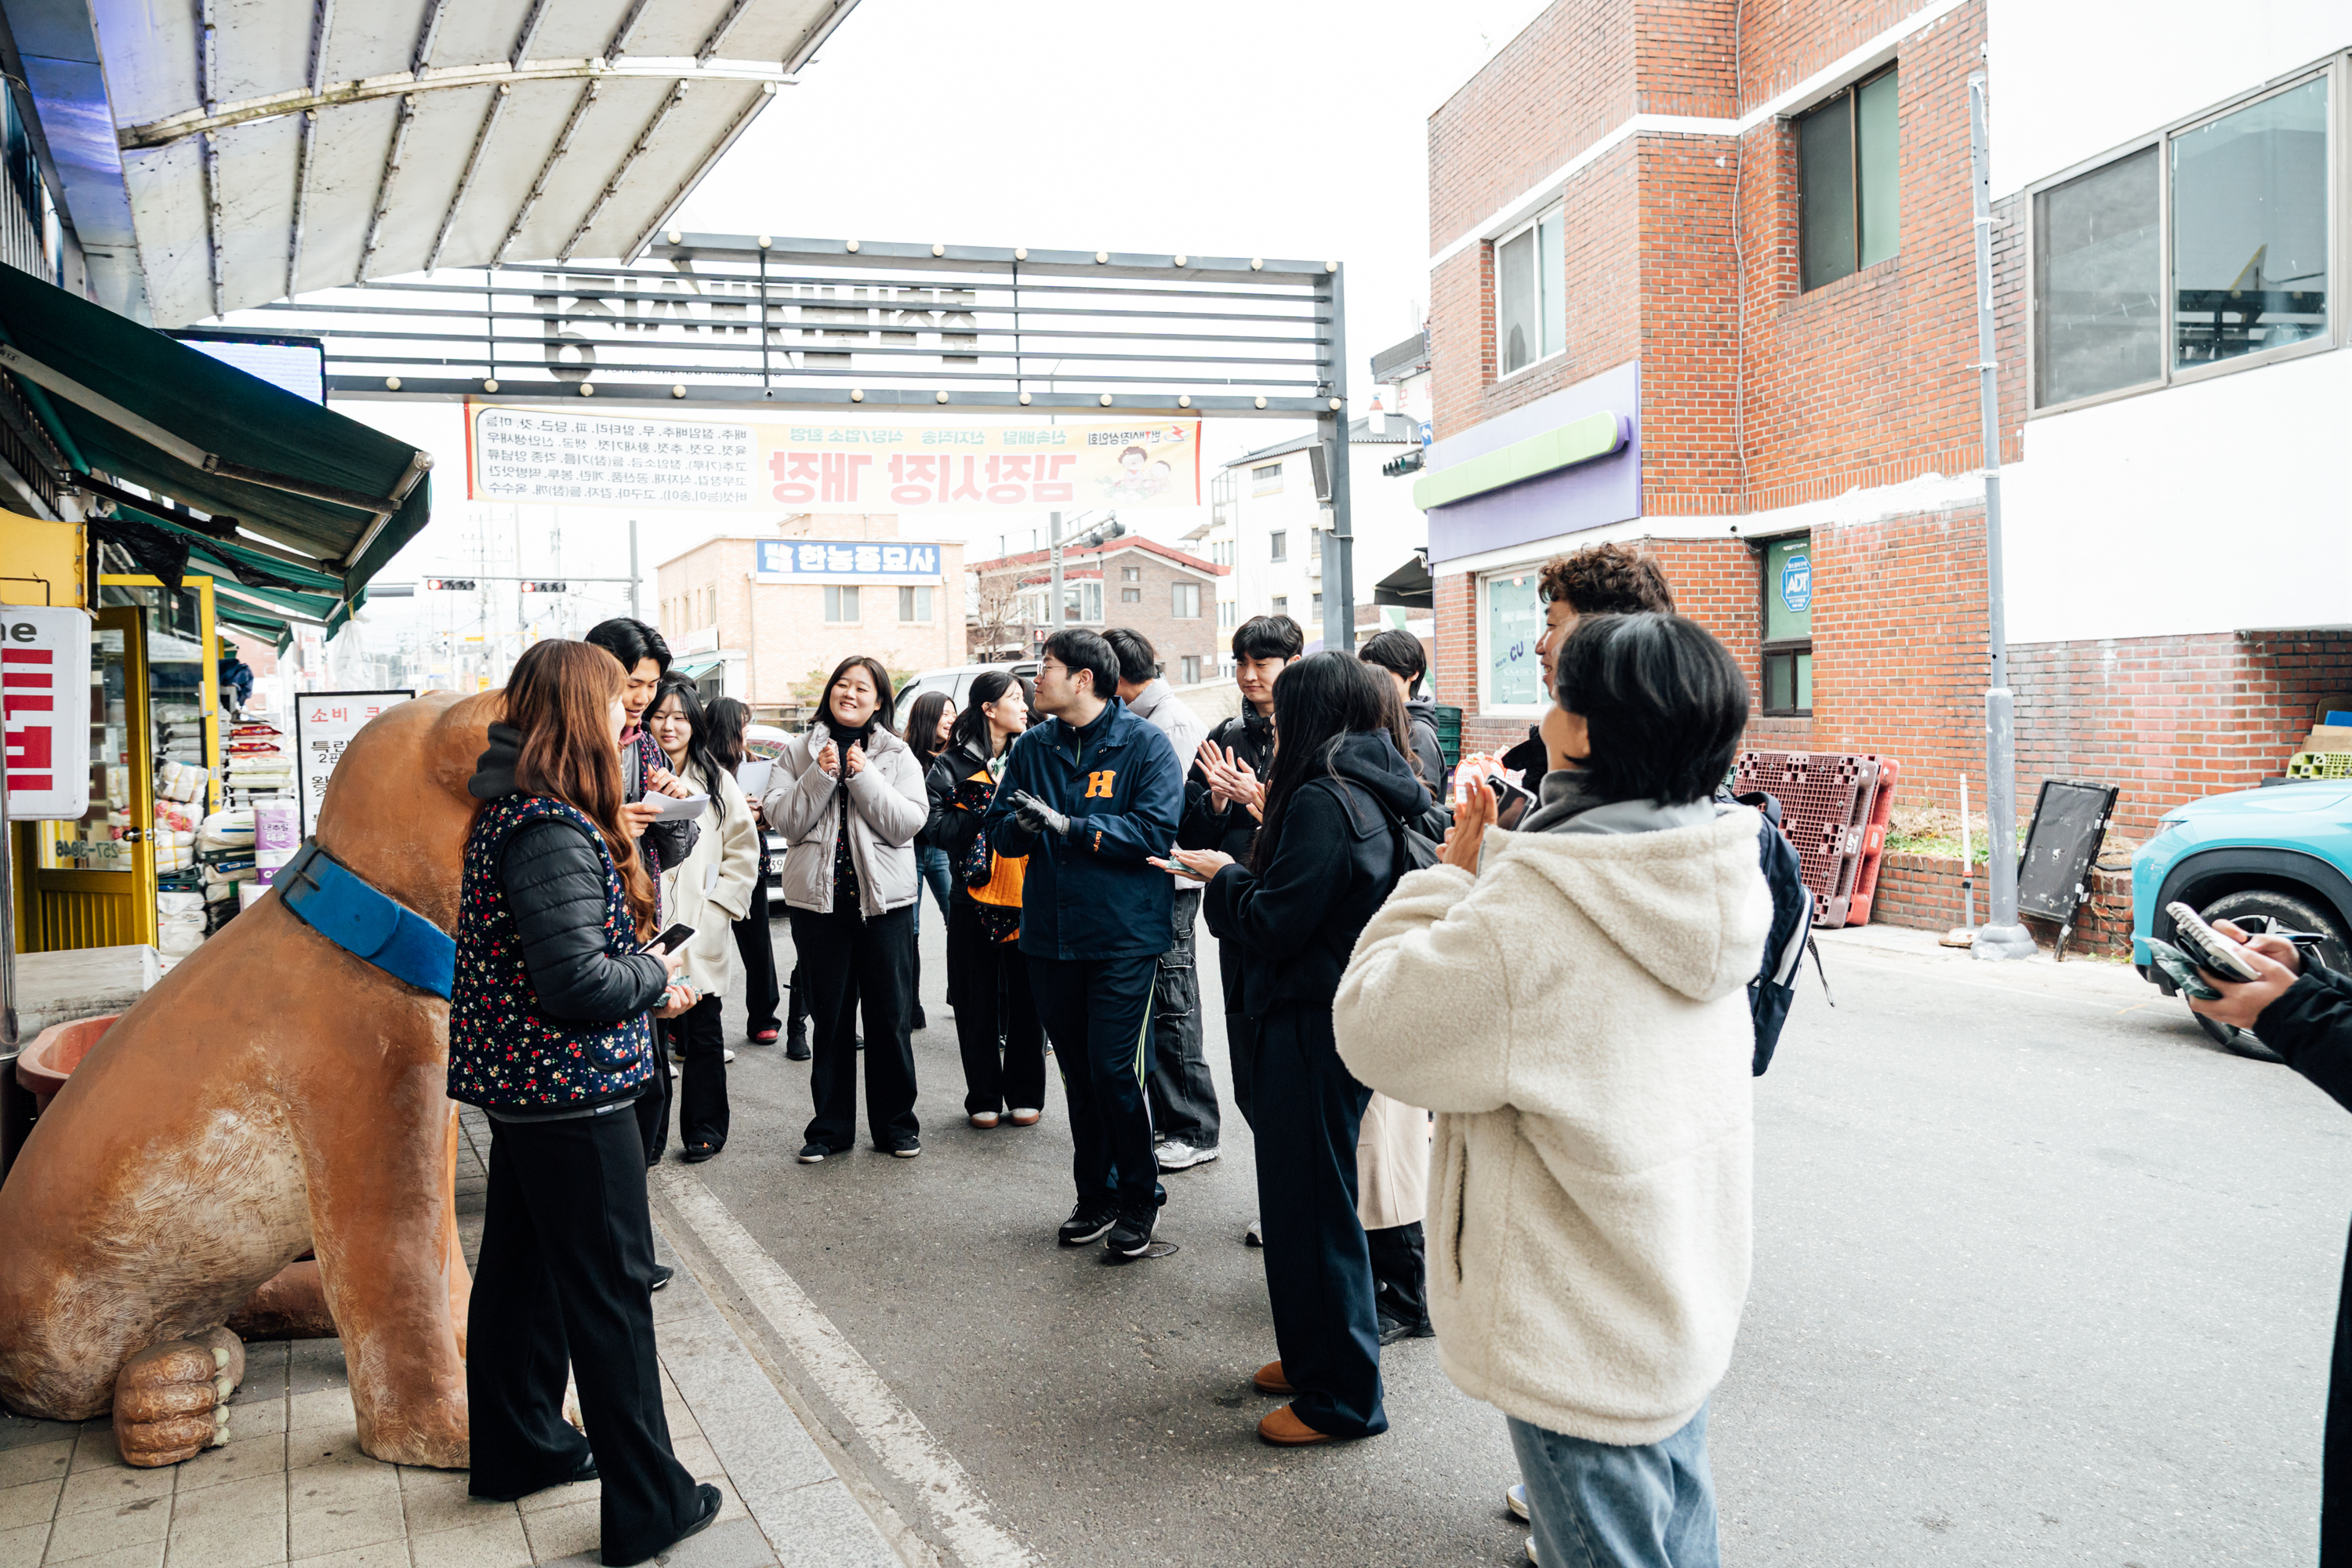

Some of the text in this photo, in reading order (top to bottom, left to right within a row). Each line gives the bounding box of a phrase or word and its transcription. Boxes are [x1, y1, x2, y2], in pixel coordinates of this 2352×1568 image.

[798, 544, 935, 572] 한농종묘사
[1786, 572, 1809, 594] ADT
[1510, 641, 1523, 662] CU
[310, 707, 347, 722] 소비
[311, 775, 329, 789] 왕
[1084, 770, 1116, 798] H
[1845, 833, 1853, 853] KPP
